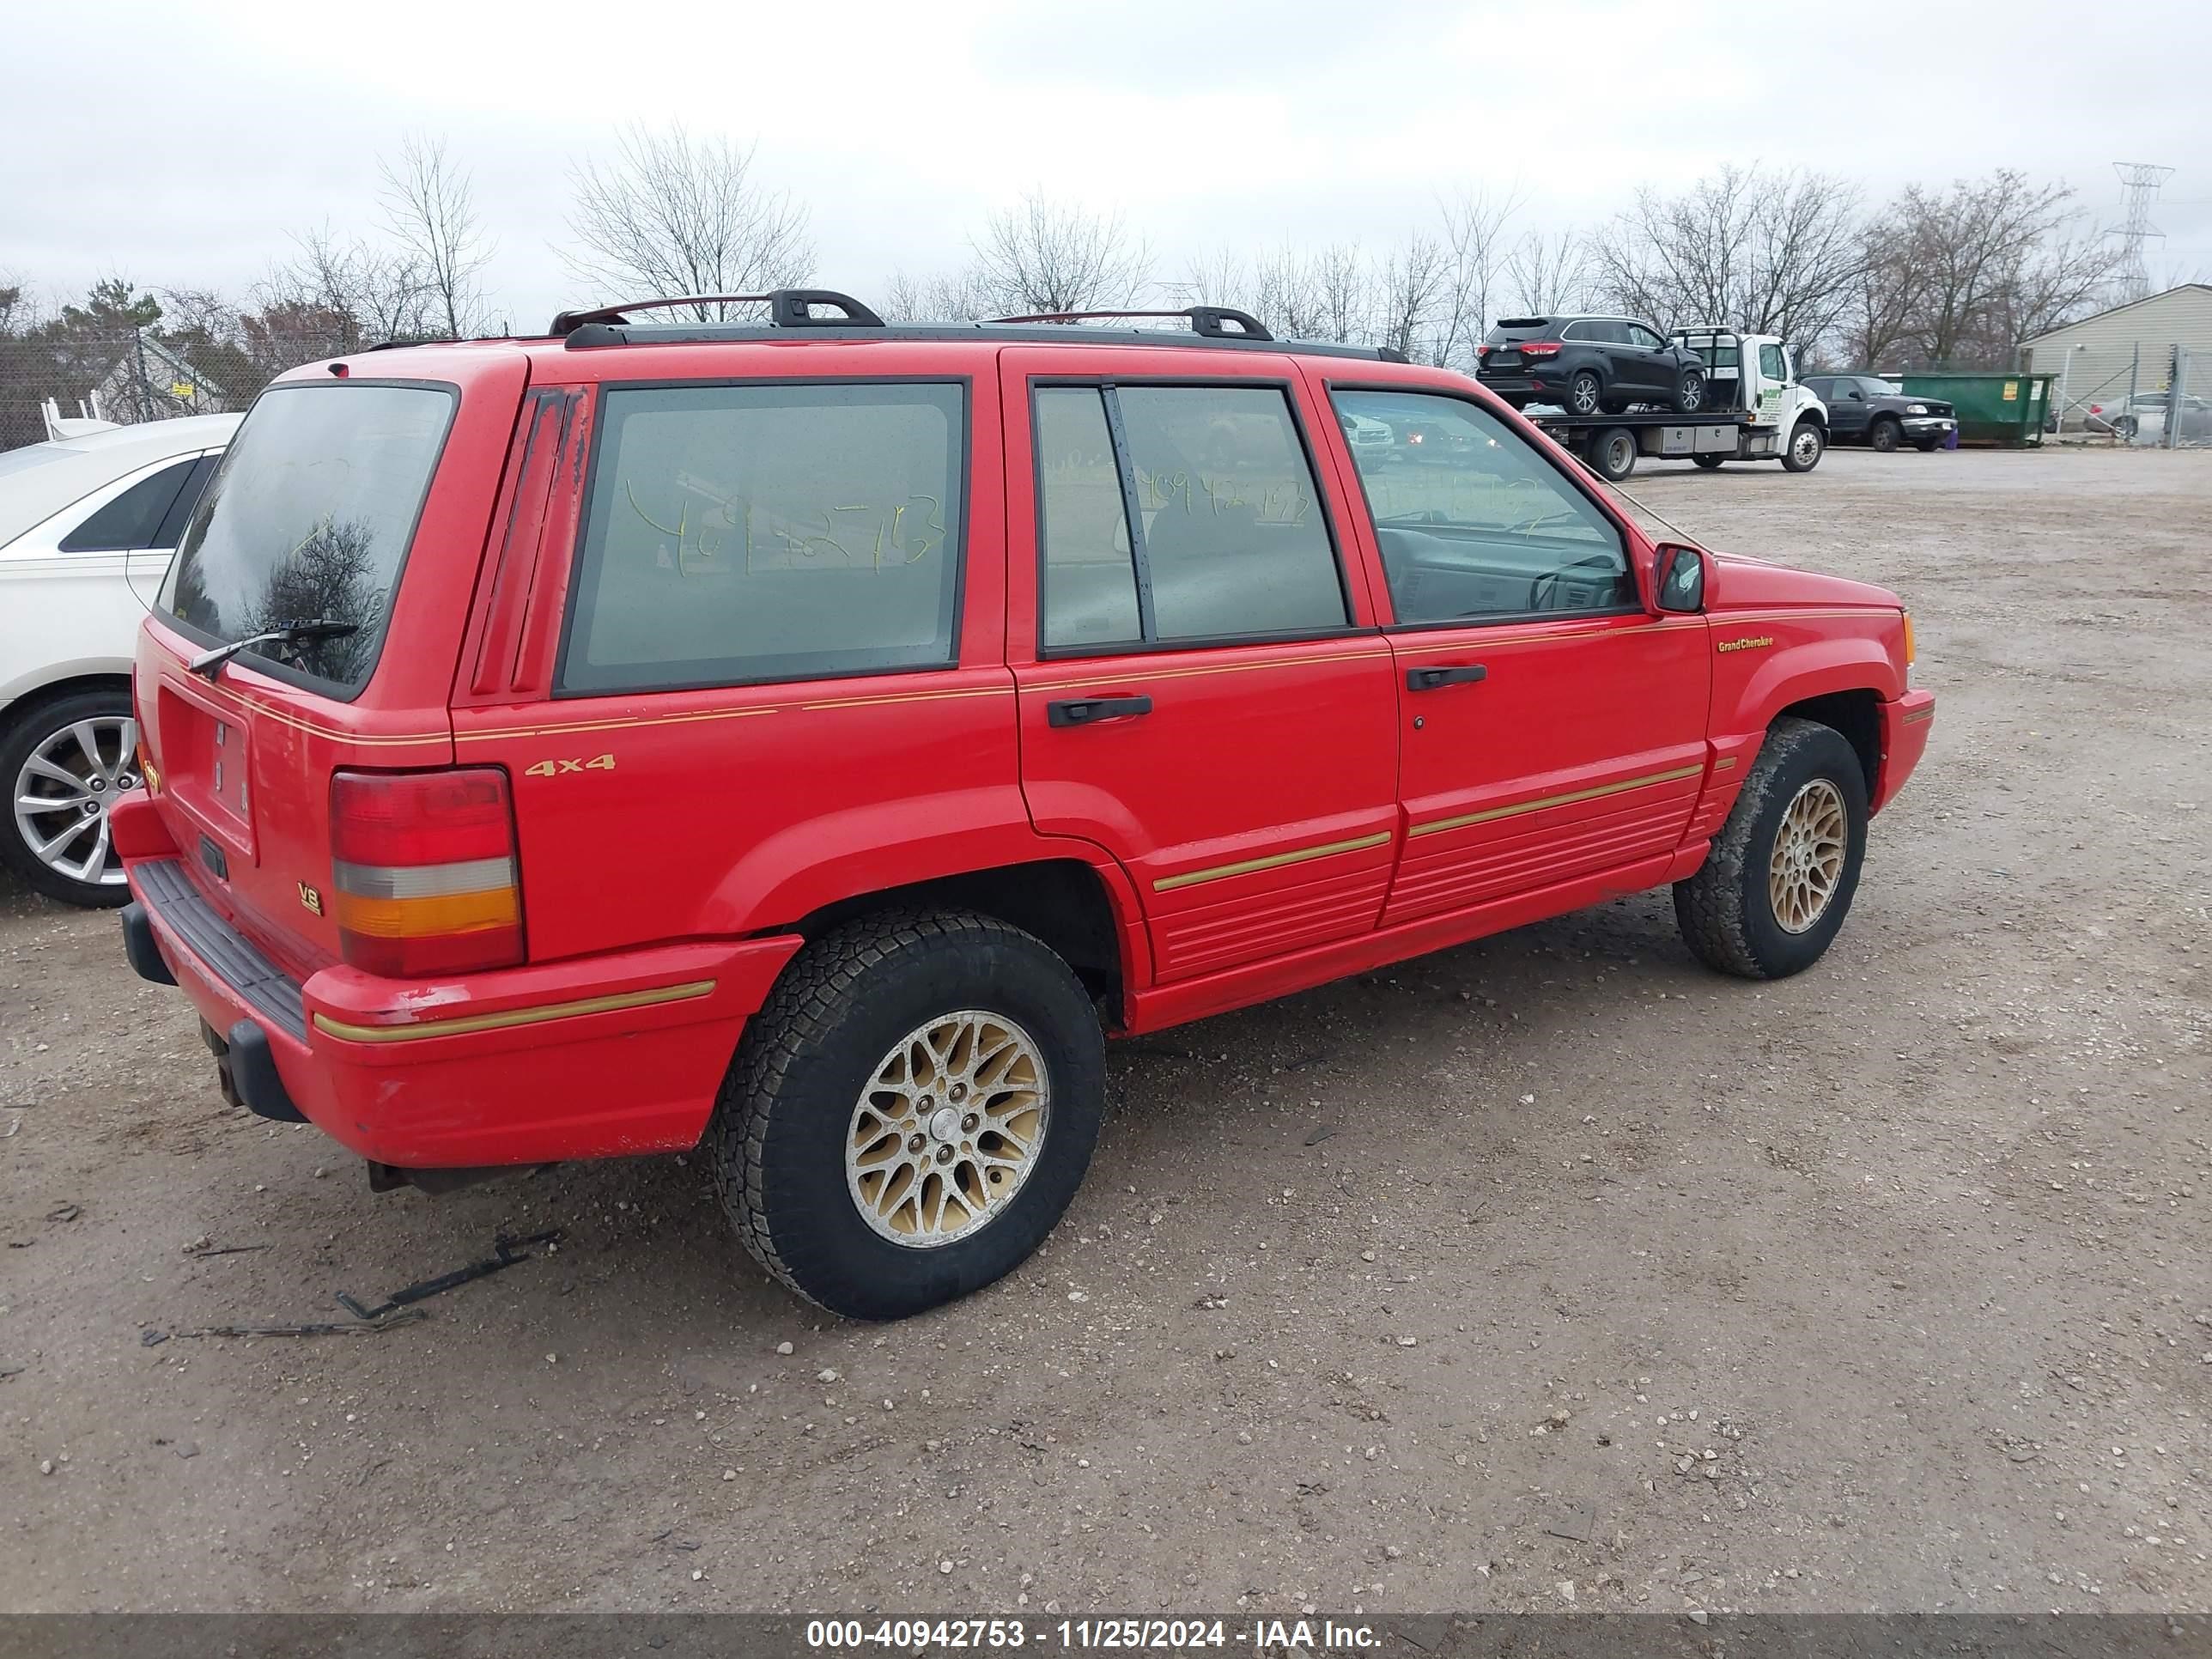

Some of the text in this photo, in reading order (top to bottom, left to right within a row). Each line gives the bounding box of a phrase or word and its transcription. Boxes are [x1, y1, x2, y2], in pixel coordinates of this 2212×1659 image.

[1717, 635, 1773, 653] Grand Cherokee
[297, 882, 319, 908] V8
